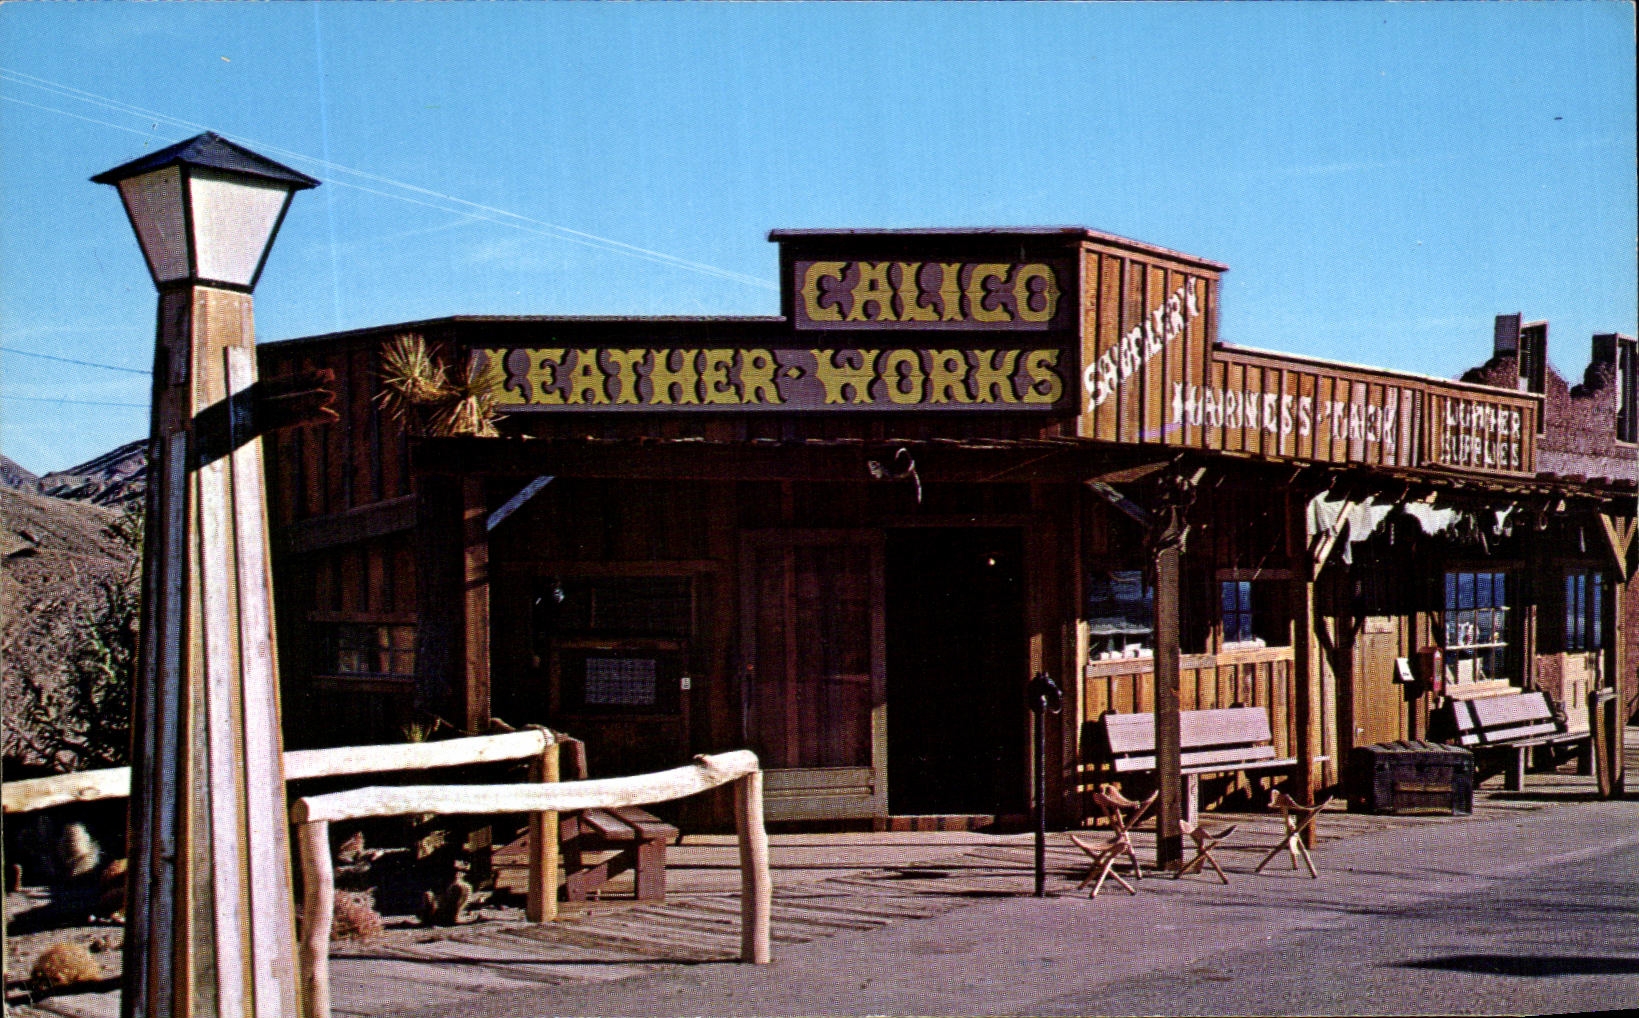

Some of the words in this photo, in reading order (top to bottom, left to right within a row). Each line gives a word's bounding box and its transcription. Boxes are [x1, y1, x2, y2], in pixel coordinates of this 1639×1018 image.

[801, 260, 1060, 323] CALICO
[1084, 277, 1199, 413] SADDLERY
[484, 348, 788, 405] LEATHER
[810, 348, 1063, 405] WORKS
[1172, 382, 1312, 436] HARNESS
[1445, 397, 1520, 440] LEATHER
[1442, 427, 1519, 467] SUPPLIES
